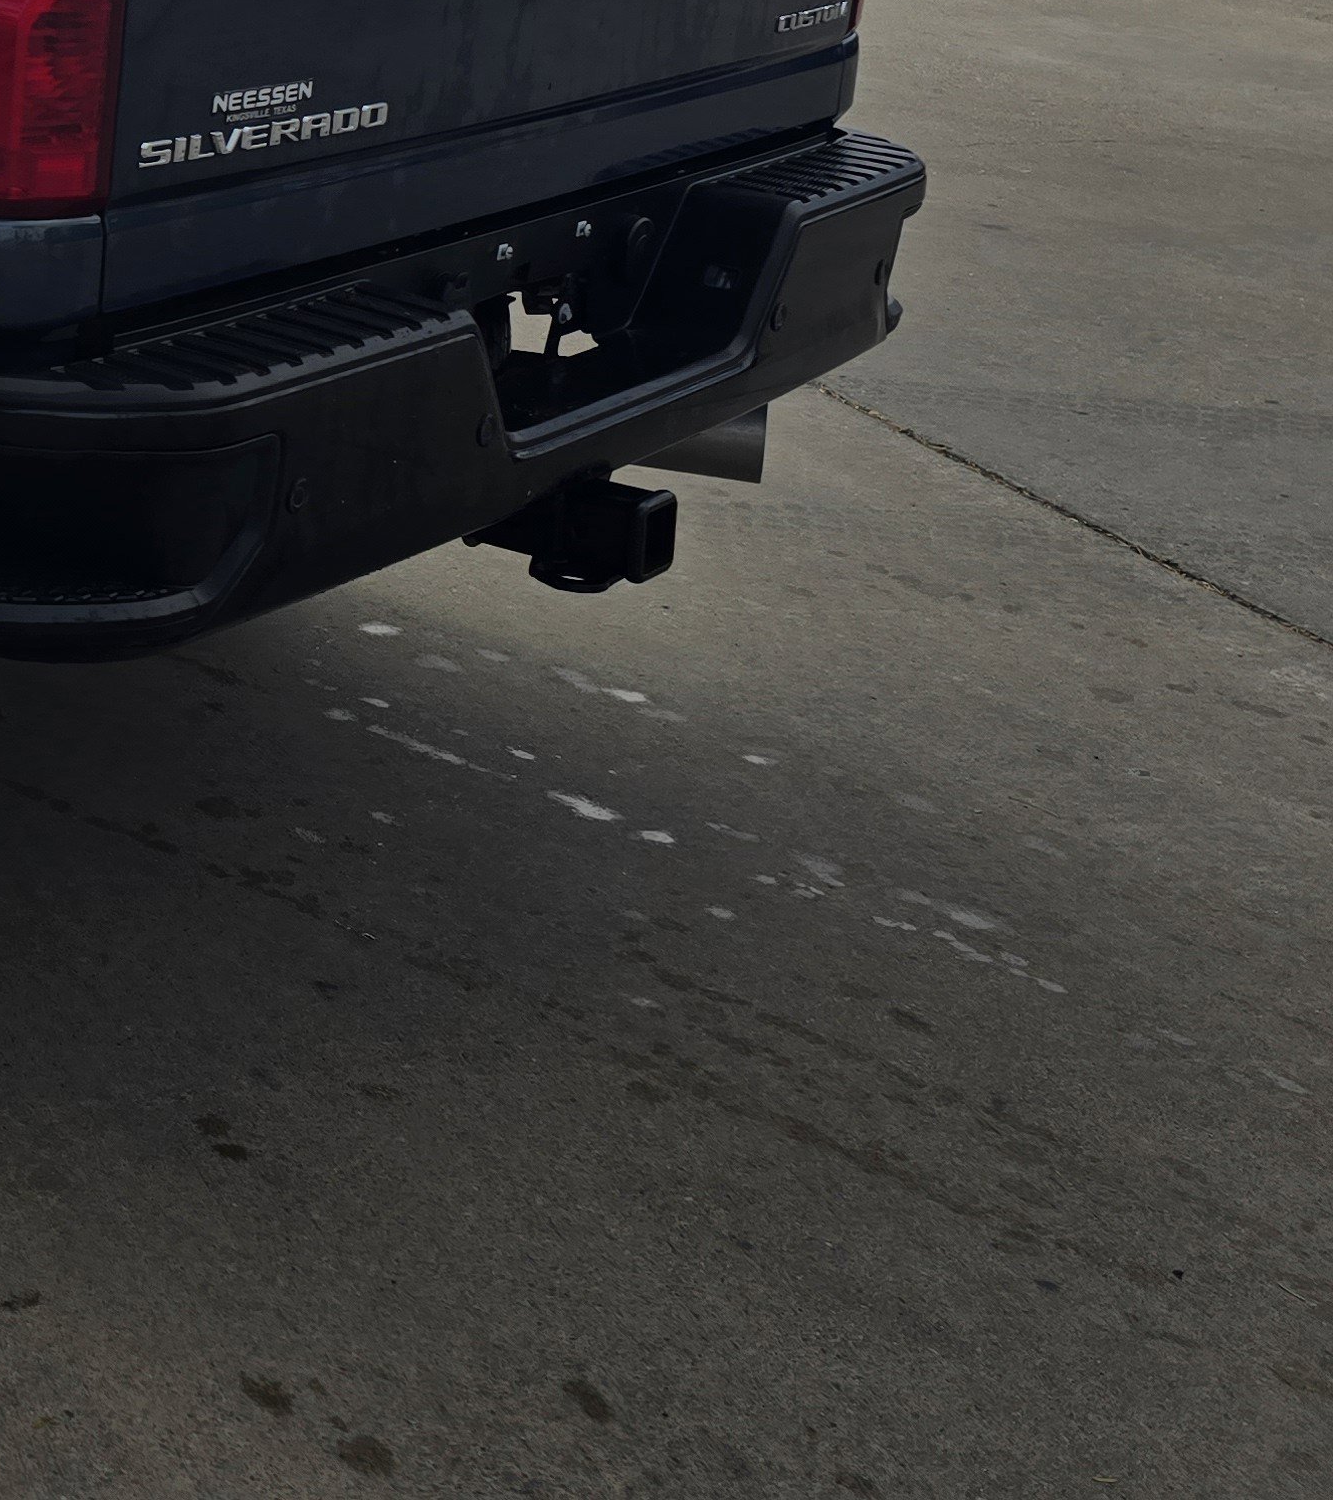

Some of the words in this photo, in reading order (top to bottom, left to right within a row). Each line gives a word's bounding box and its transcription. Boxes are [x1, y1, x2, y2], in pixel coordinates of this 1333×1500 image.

[777, 1, 849, 33] CUSTOM
[212, 80, 314, 113] NEESSEN
[273, 104, 297, 117] TEXAS
[139, 102, 389, 169] SILVERADO
